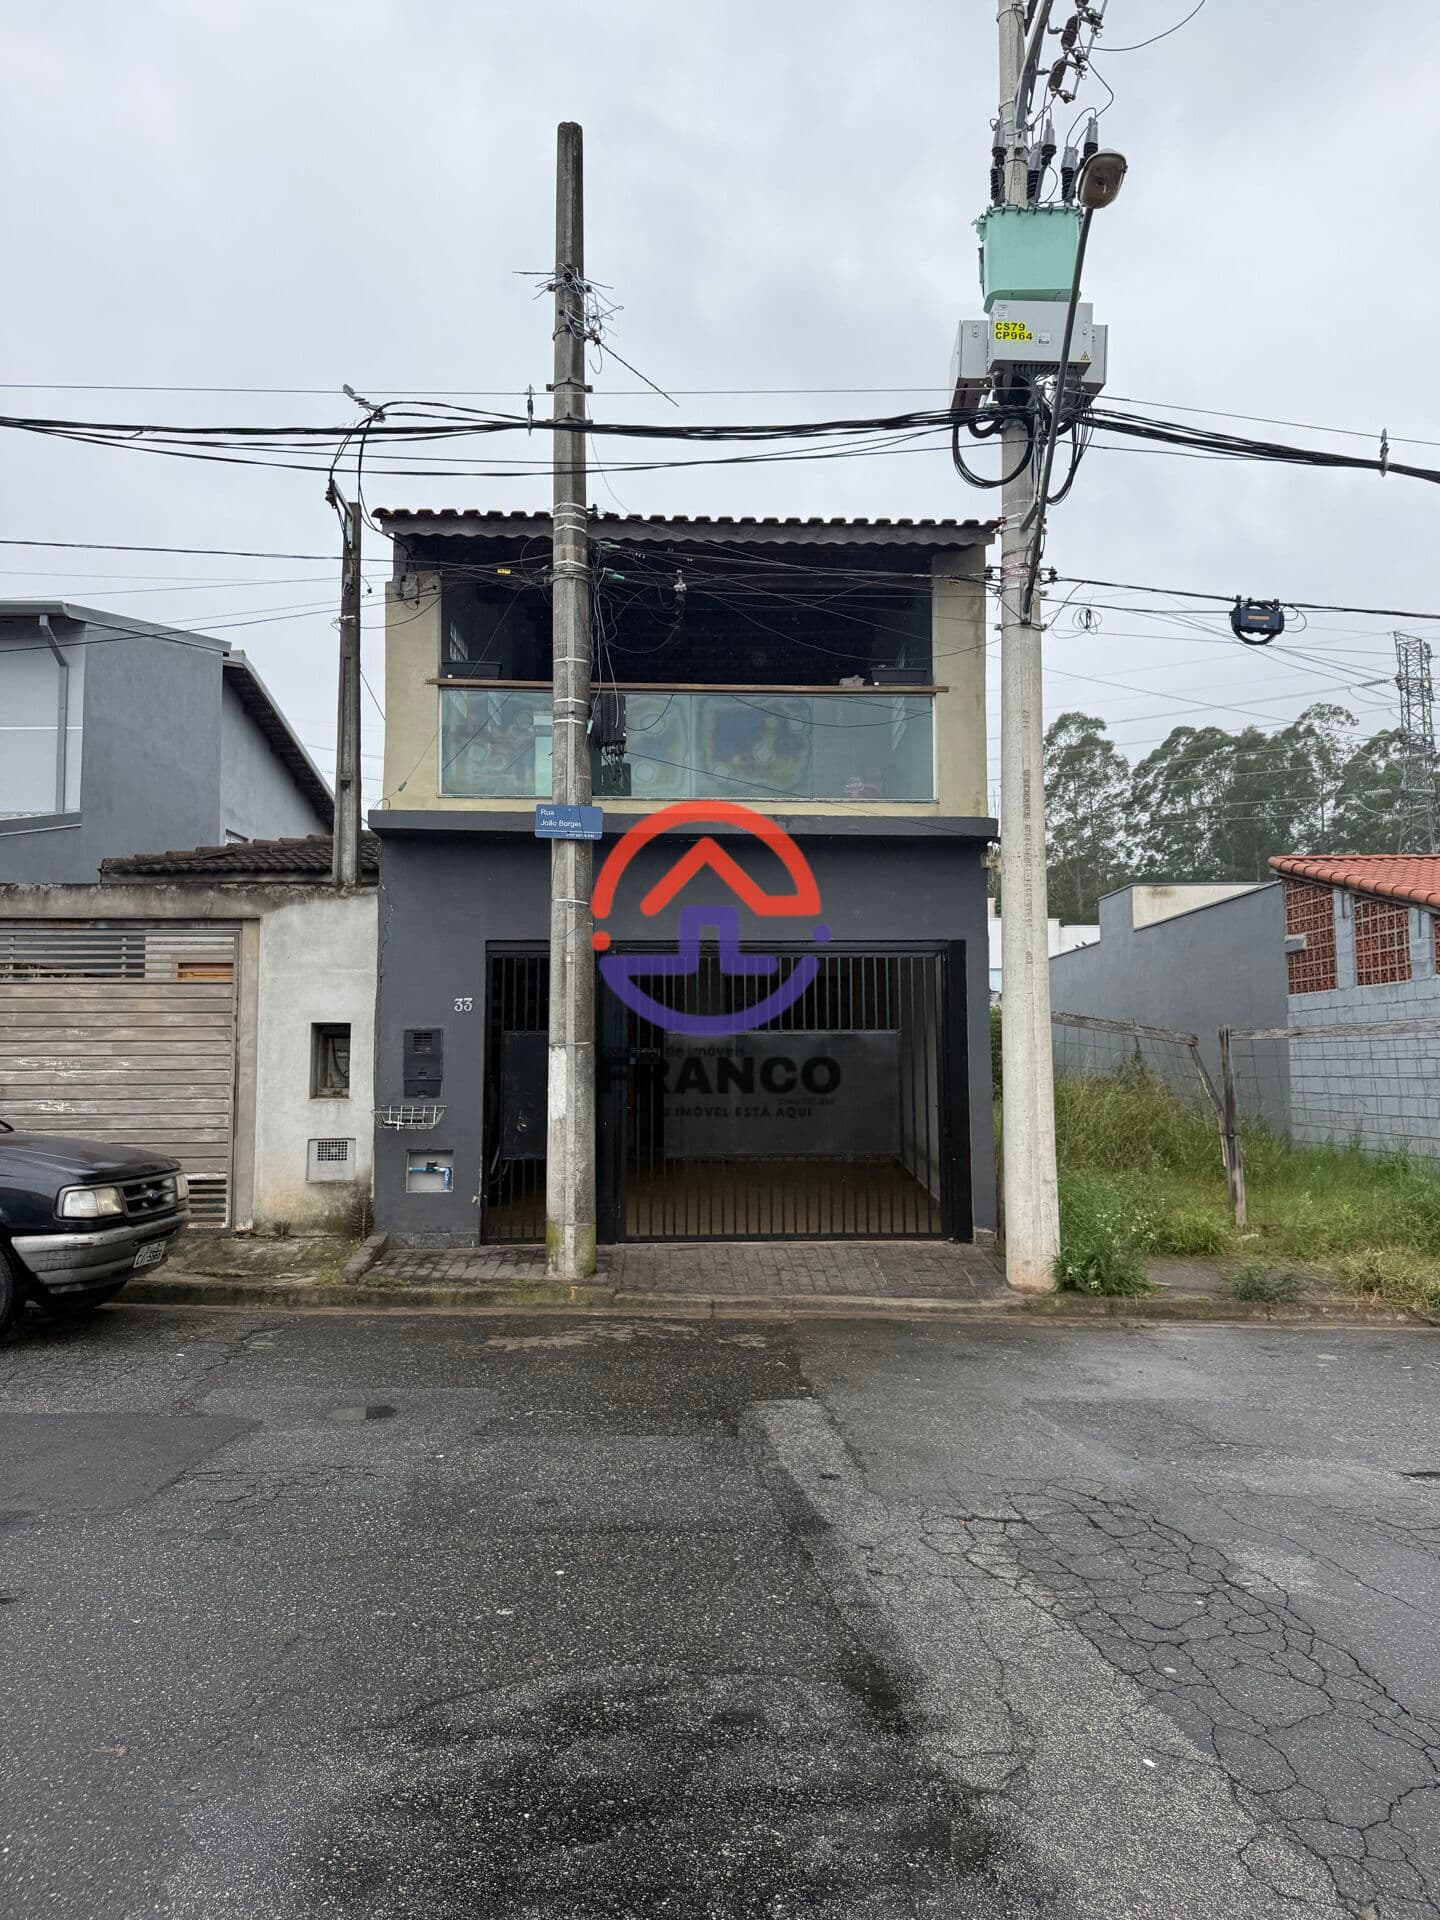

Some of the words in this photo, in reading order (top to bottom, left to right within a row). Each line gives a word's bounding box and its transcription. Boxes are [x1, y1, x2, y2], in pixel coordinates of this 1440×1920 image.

[995, 322, 1026, 332] CS79
[995, 331, 1033, 341] CP964
[540, 808, 555, 816] Rua
[540, 819, 558, 827] João
[558, 819, 582, 829] Borges
[454, 997, 473, 1012] 33
